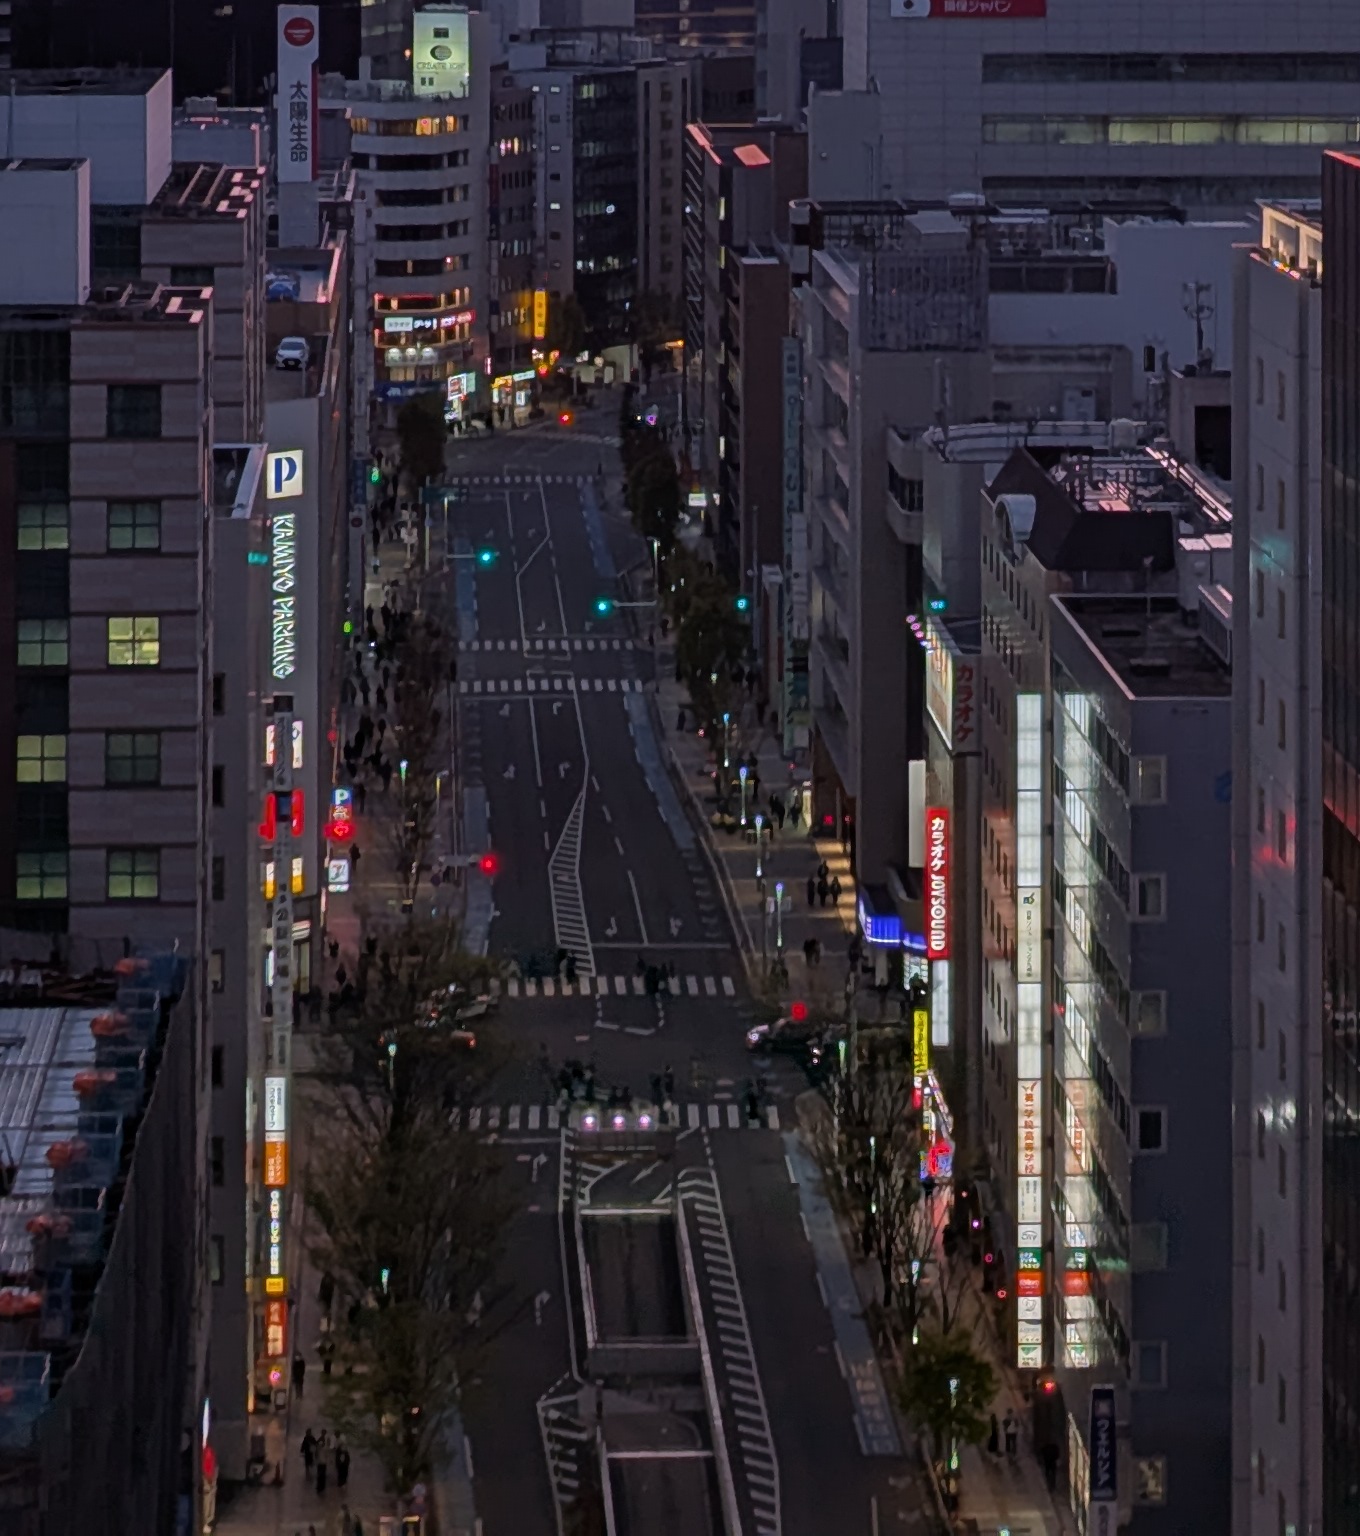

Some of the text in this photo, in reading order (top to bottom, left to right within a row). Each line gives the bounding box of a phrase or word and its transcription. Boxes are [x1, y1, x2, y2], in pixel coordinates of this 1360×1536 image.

[289, 80, 309, 163] 太陽生命
[273, 455, 298, 494] P
[272, 596, 296, 680] PARKING
[954, 663, 975, 744] カラオケ
[930, 816, 946, 951] カラオケ JOYSOUND
